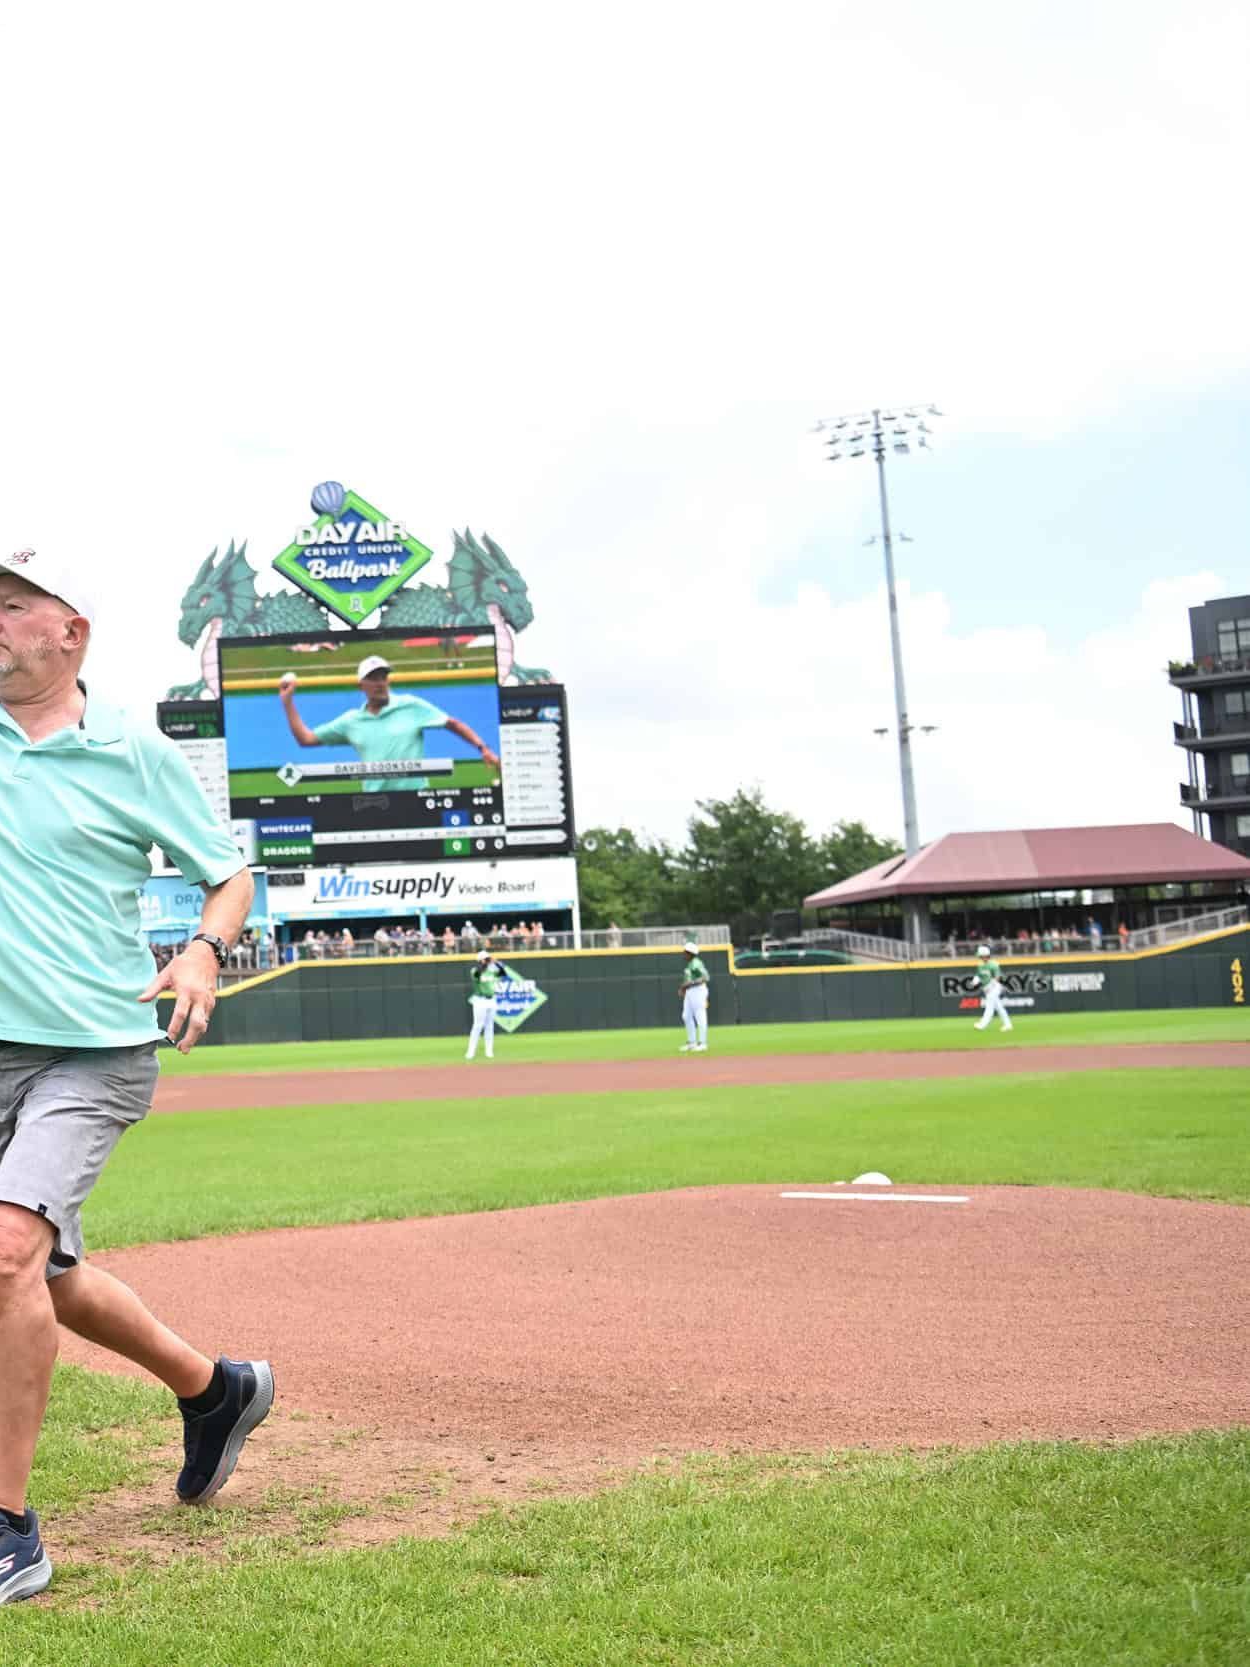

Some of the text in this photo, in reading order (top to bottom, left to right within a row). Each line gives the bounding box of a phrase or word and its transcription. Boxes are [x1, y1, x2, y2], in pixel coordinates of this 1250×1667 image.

[295, 520, 410, 545] DAY AIR
[303, 544, 403, 557] CREDIT UNION
[306, 557, 402, 583] Ballpark
[260, 823, 312, 834] WHITECAPS
[262, 846, 312, 857] DRAGONS
[319, 871, 455, 899] Winsupply
[458, 882, 493, 894] Video
[498, 880, 535, 893] Board
[1230, 957, 1245, 1003] 402
